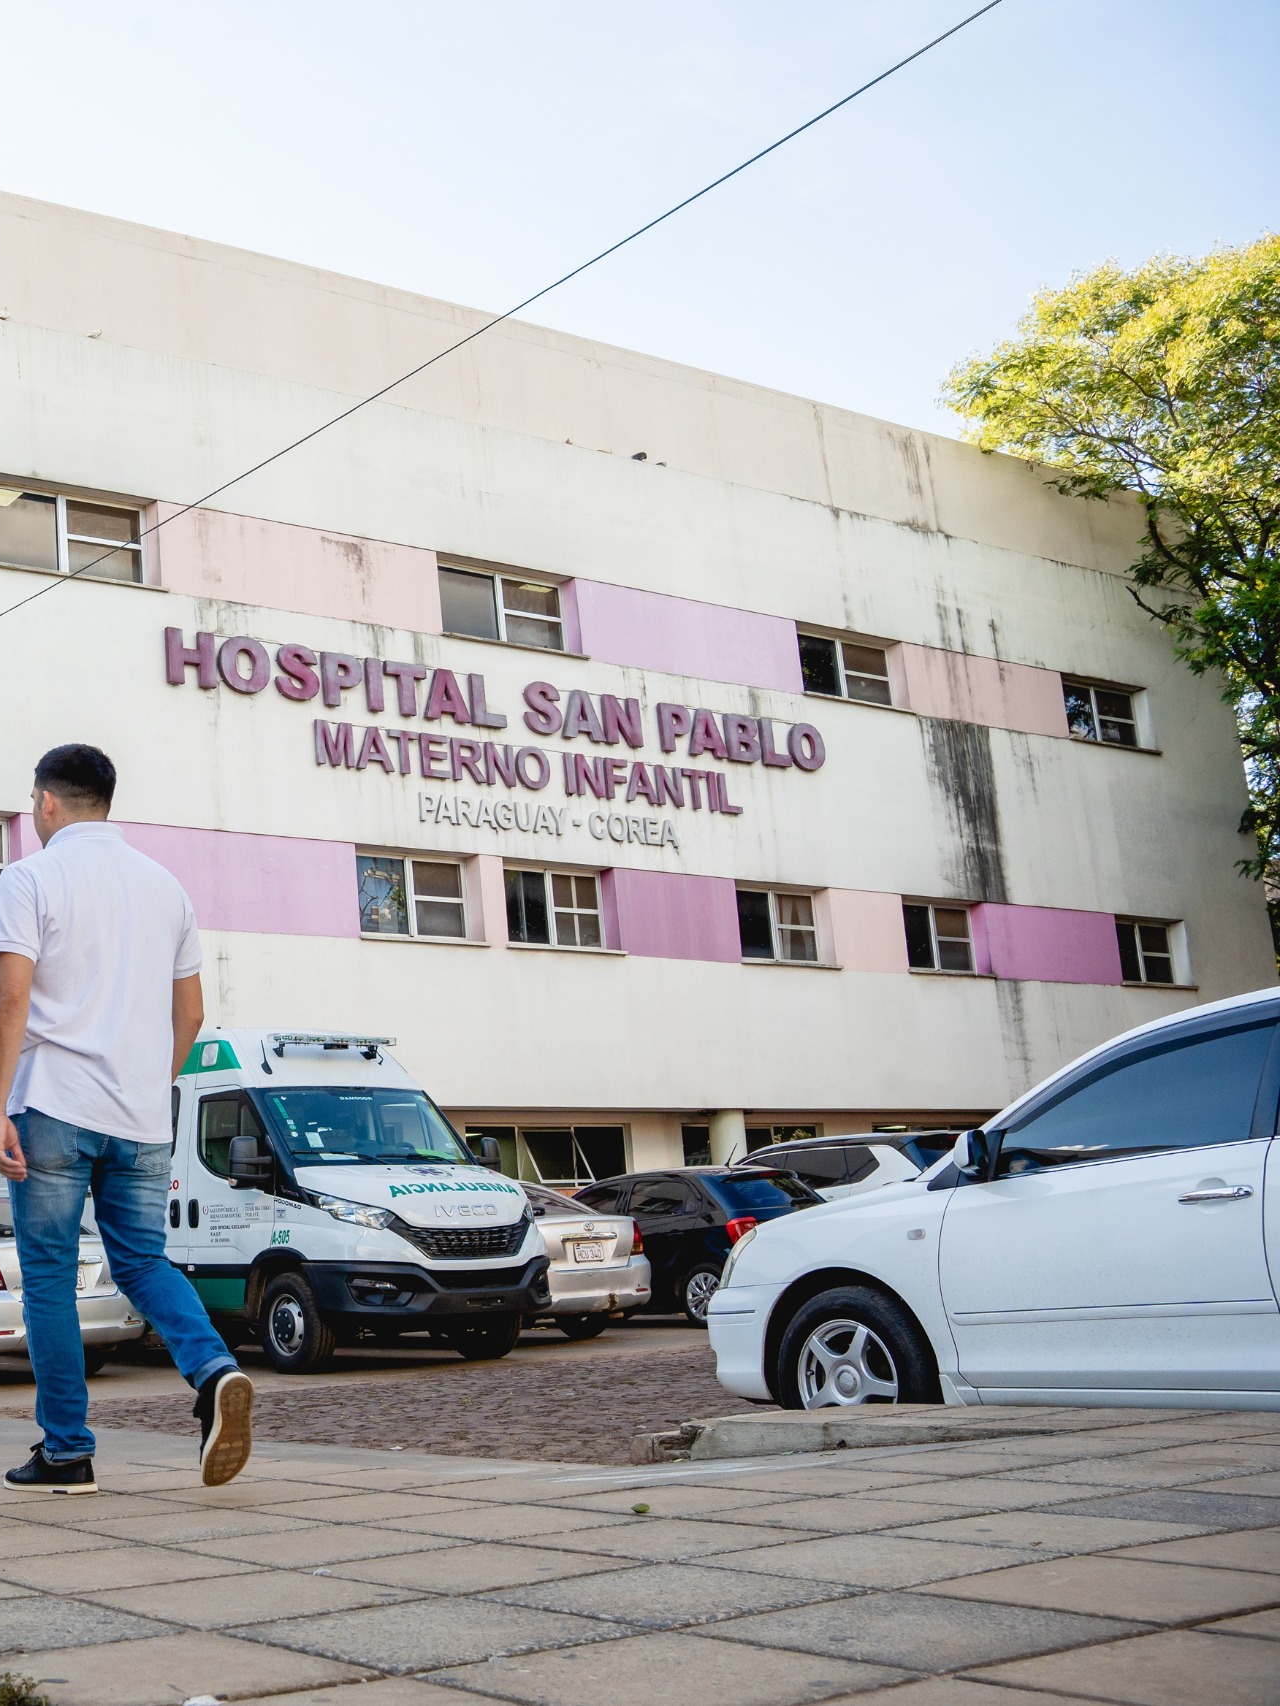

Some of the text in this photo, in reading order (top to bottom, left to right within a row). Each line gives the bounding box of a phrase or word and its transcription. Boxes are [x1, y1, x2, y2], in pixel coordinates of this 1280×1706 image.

[164, 626, 827, 772] HOSPITAL SAN PABLO
[313, 718, 744, 815] MATERNO INFANTIL
[419, 791, 569, 836] PARAGUAY
[588, 810, 680, 850] COREA
[272, 1229, 291, 1245] A-505
[433, 1203, 498, 1218] IVECO
